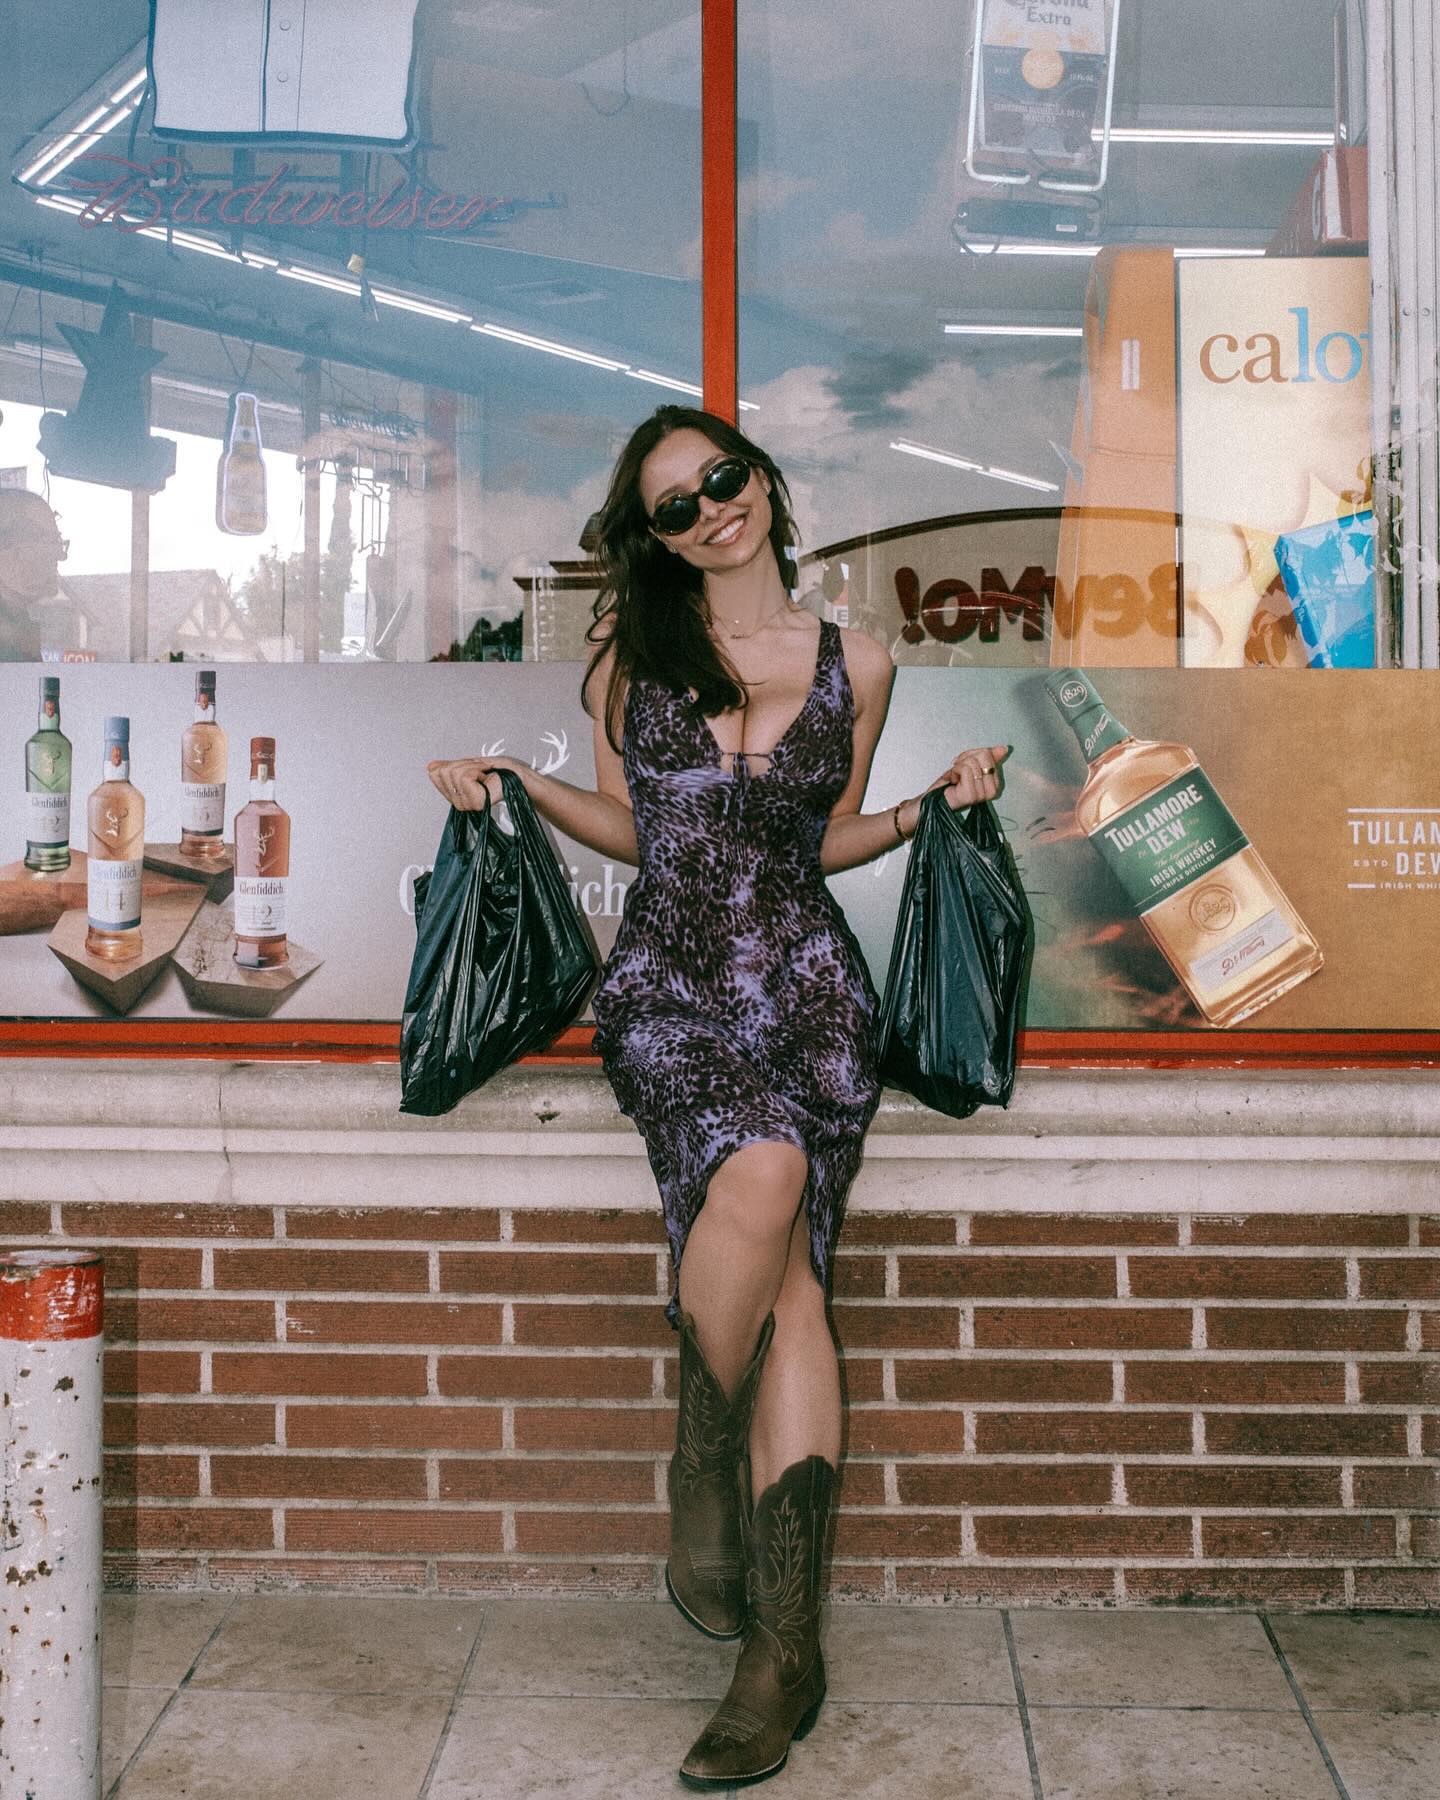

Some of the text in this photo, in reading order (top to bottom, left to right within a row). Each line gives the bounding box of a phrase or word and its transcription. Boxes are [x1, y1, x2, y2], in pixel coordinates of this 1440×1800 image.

[1006, 0, 1089, 9] rona
[1027, 5, 1072, 25] Extra
[69, 153, 512, 233] Budweiser
[1063, 686, 1084, 702] 1829
[1104, 784, 1203, 853] TULLAMORE
[1150, 838, 1217, 888] IRISH WHISKEY
[1162, 854, 1216, 891] TRIPLE DISTILLED
[239, 881, 284, 895] Glenfiddich
[1380, 882, 1412, 890] IRISH
